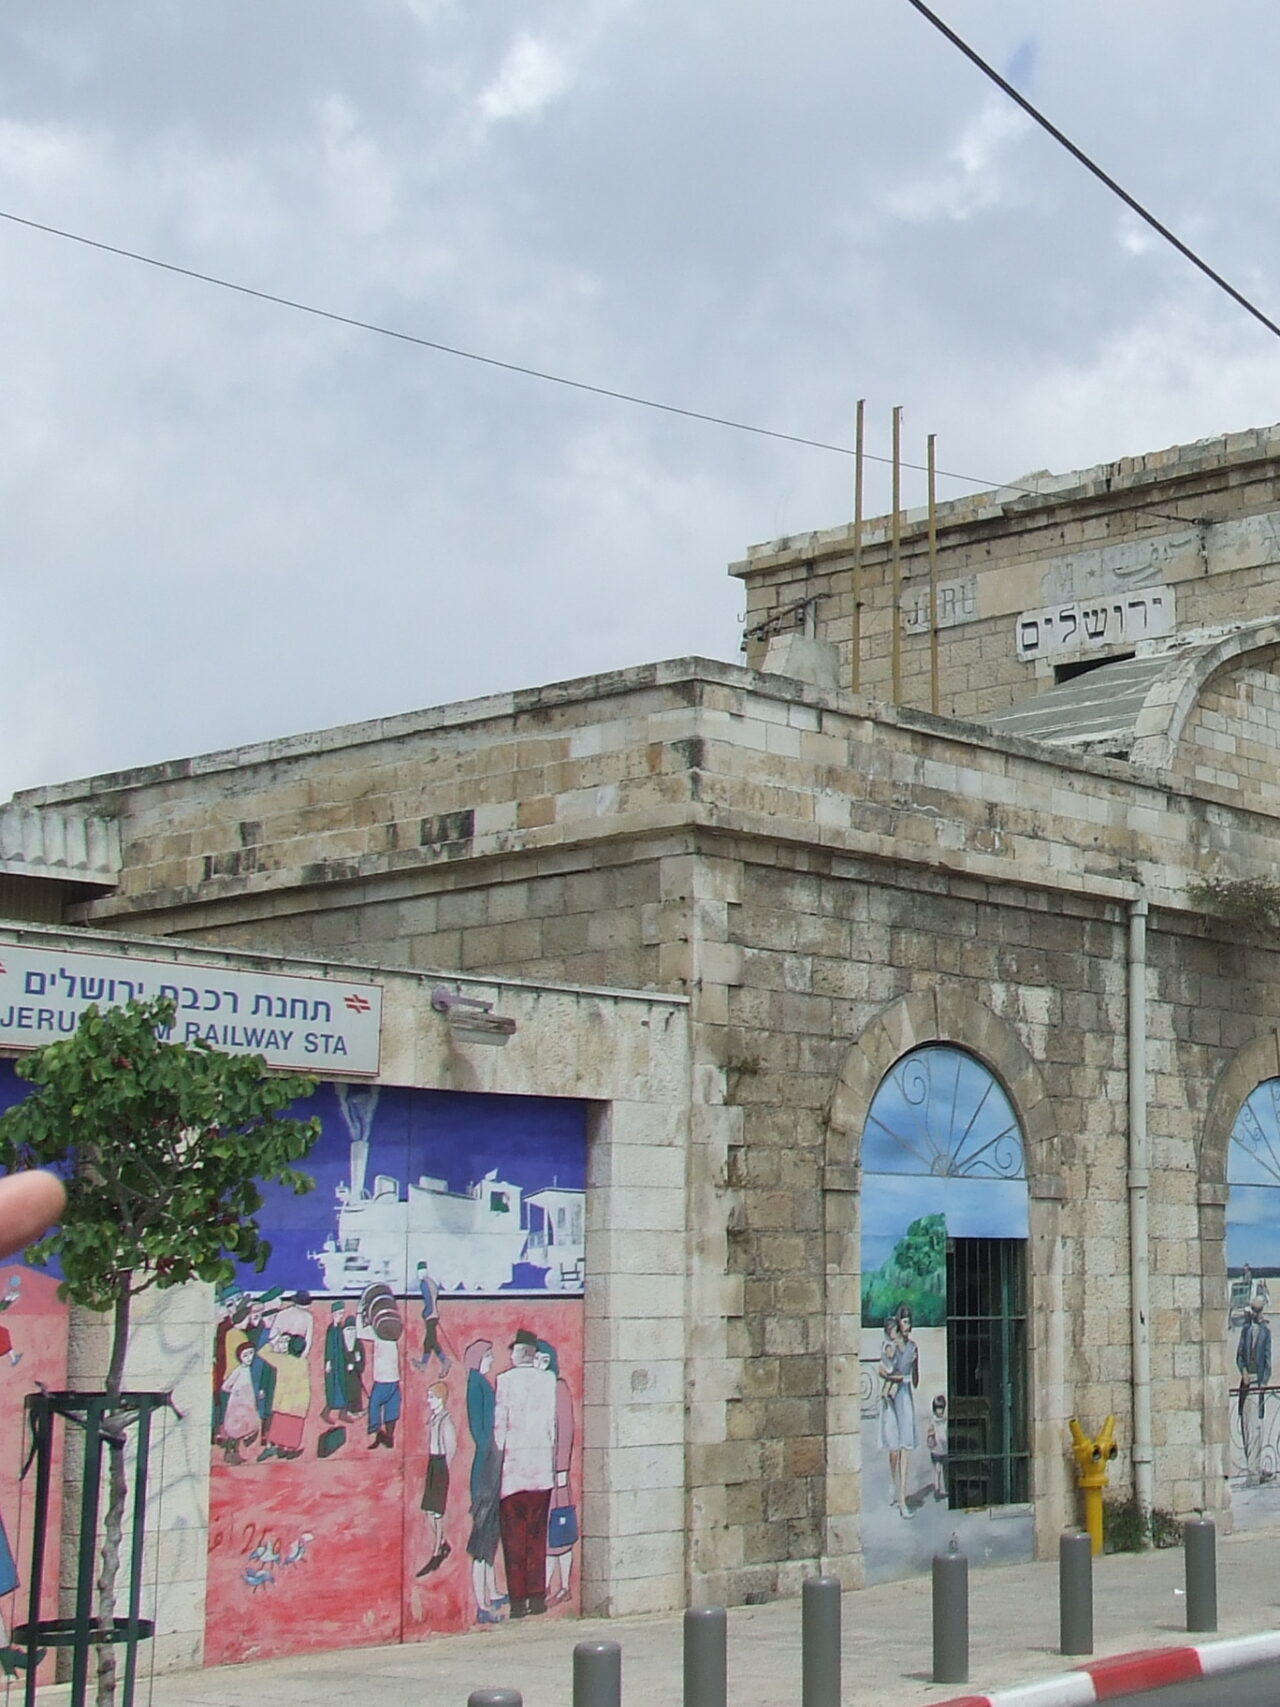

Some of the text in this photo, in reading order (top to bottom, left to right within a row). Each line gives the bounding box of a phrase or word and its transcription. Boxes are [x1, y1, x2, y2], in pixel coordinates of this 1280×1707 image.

[1020, 597, 1163, 651] ירושלים
[24, 967, 144, 1002] ירושלים
[250, 993, 332, 1023] תחנת
[0, 1006, 348, 1056] JERUM RAILWAY STA
